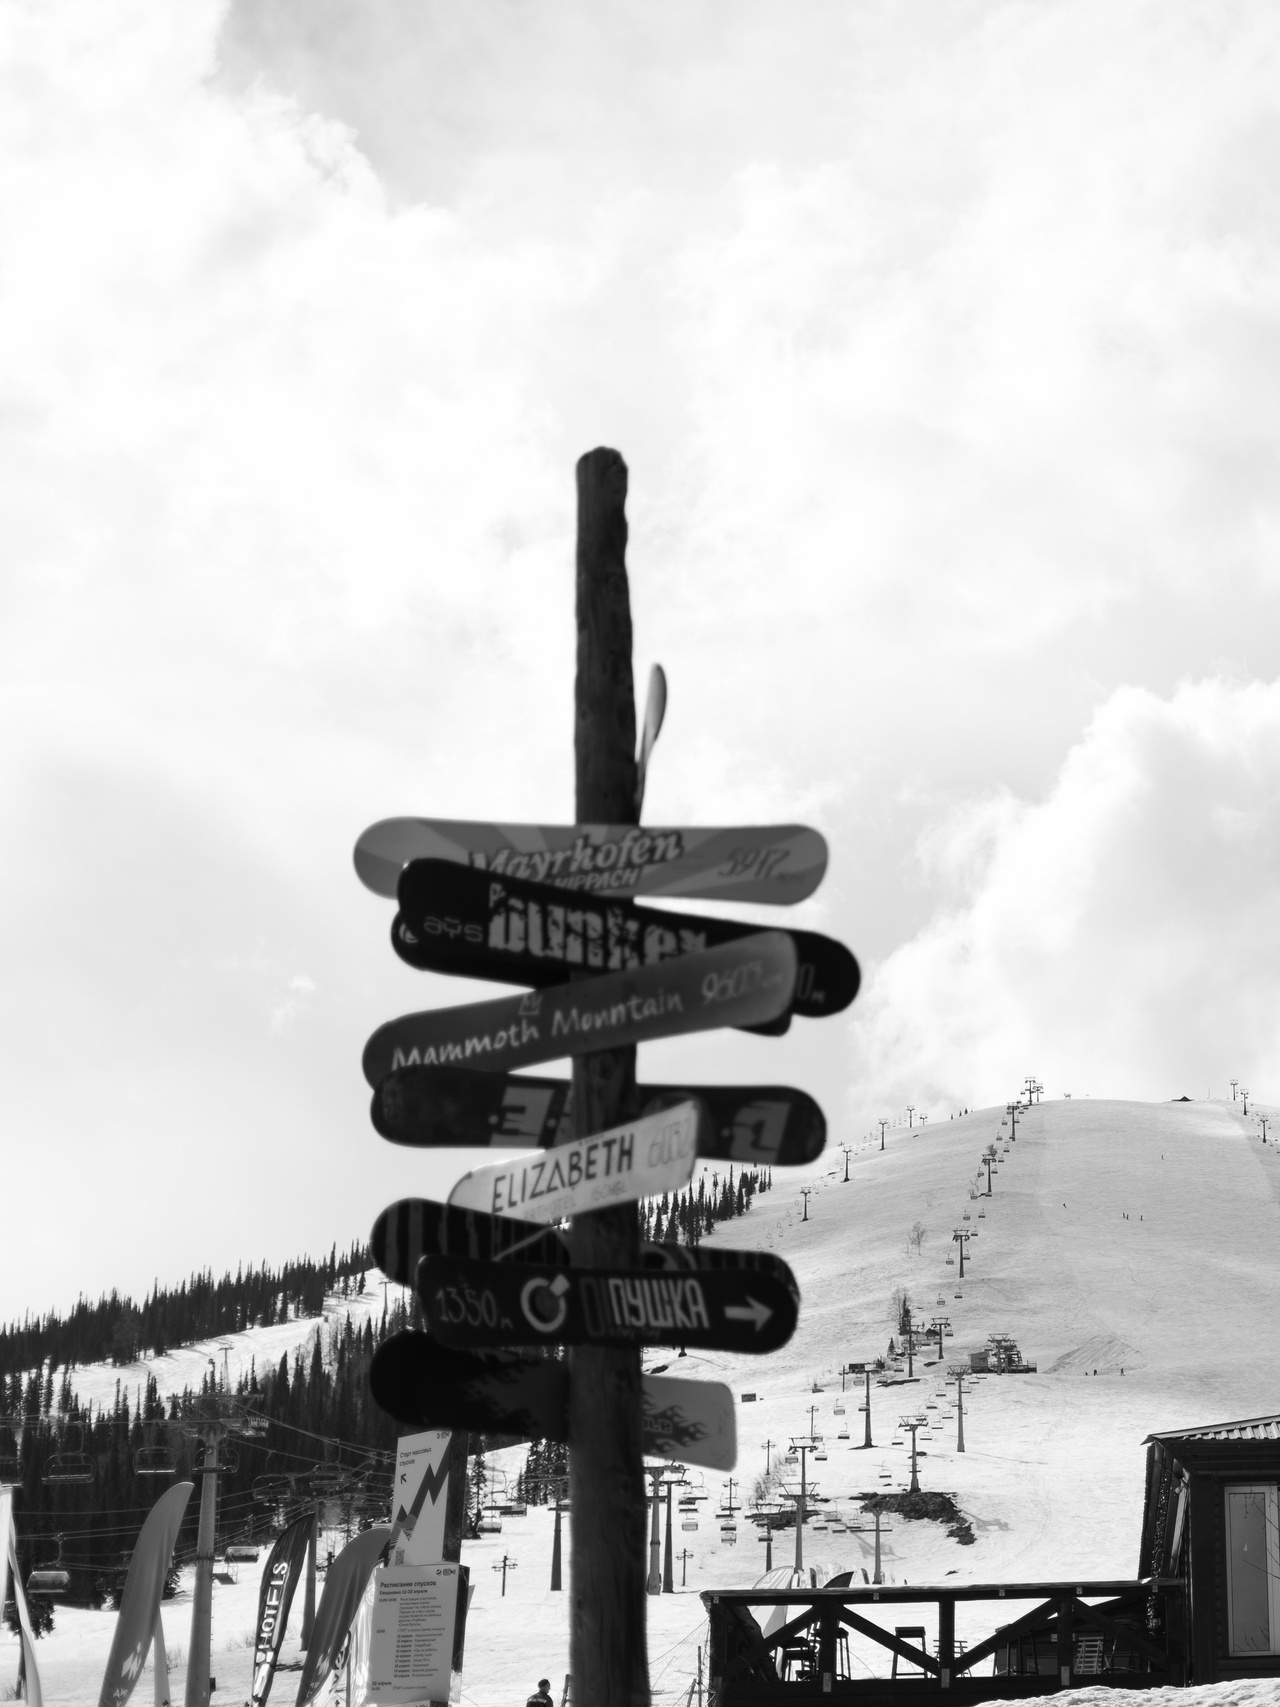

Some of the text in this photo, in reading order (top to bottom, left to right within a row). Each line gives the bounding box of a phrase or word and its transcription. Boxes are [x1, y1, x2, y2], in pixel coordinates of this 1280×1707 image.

[391, 1018, 540, 1072] Mammoth
[551, 988, 684, 1037] Mountain
[491, 1133, 635, 1214] ELIZABETH
[258, 1562, 289, 1649] HOTELS
